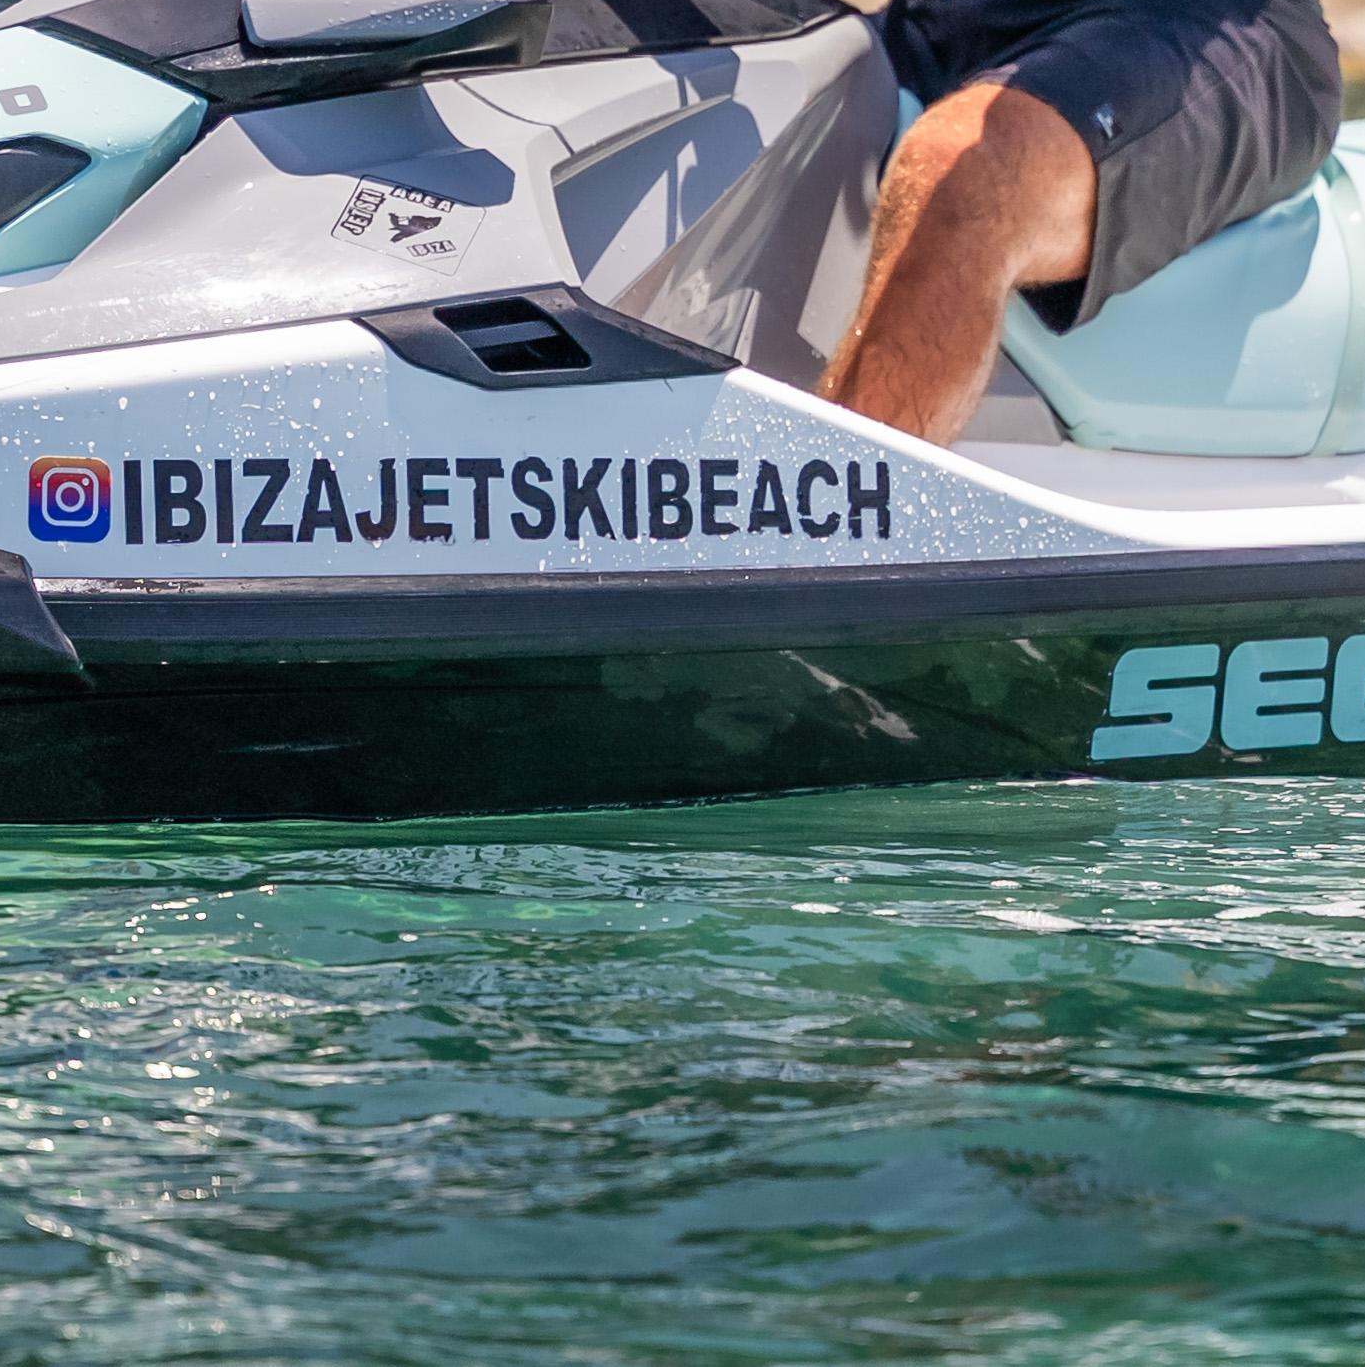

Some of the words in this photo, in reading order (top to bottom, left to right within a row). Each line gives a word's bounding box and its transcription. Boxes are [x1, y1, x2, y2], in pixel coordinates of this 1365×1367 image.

[340, 188, 386, 236] JETSKI
[406, 240, 457, 257] IBIZA
[122, 456, 891, 545] IBIZAJETSKIBEACH
